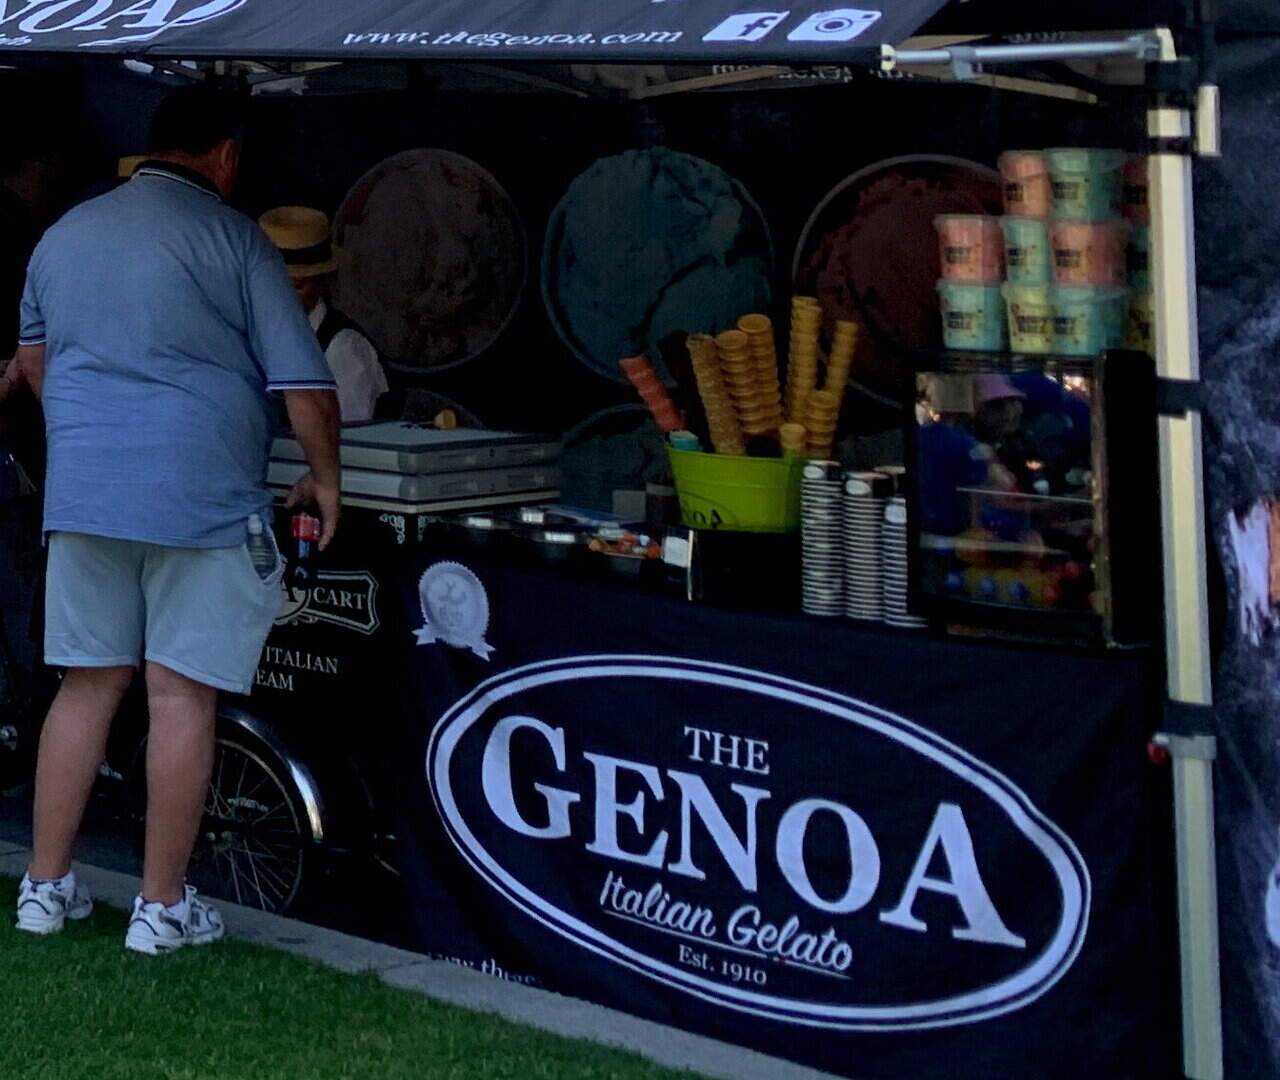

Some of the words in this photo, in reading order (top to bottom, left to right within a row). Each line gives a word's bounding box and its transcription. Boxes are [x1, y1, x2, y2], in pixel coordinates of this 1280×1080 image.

[342, 30, 686, 48] www.thegenoa.com
[313, 587, 366, 610] CART
[266, 646, 338, 674] ITALIAN
[256, 669, 294, 691] EAM
[683, 725, 771, 775] THE
[481, 715, 1027, 949] GENOA
[599, 870, 716, 938] Italian
[727, 904, 853, 970] Gelato
[679, 943, 715, 971] Est.
[721, 959, 768, 985] 1910
